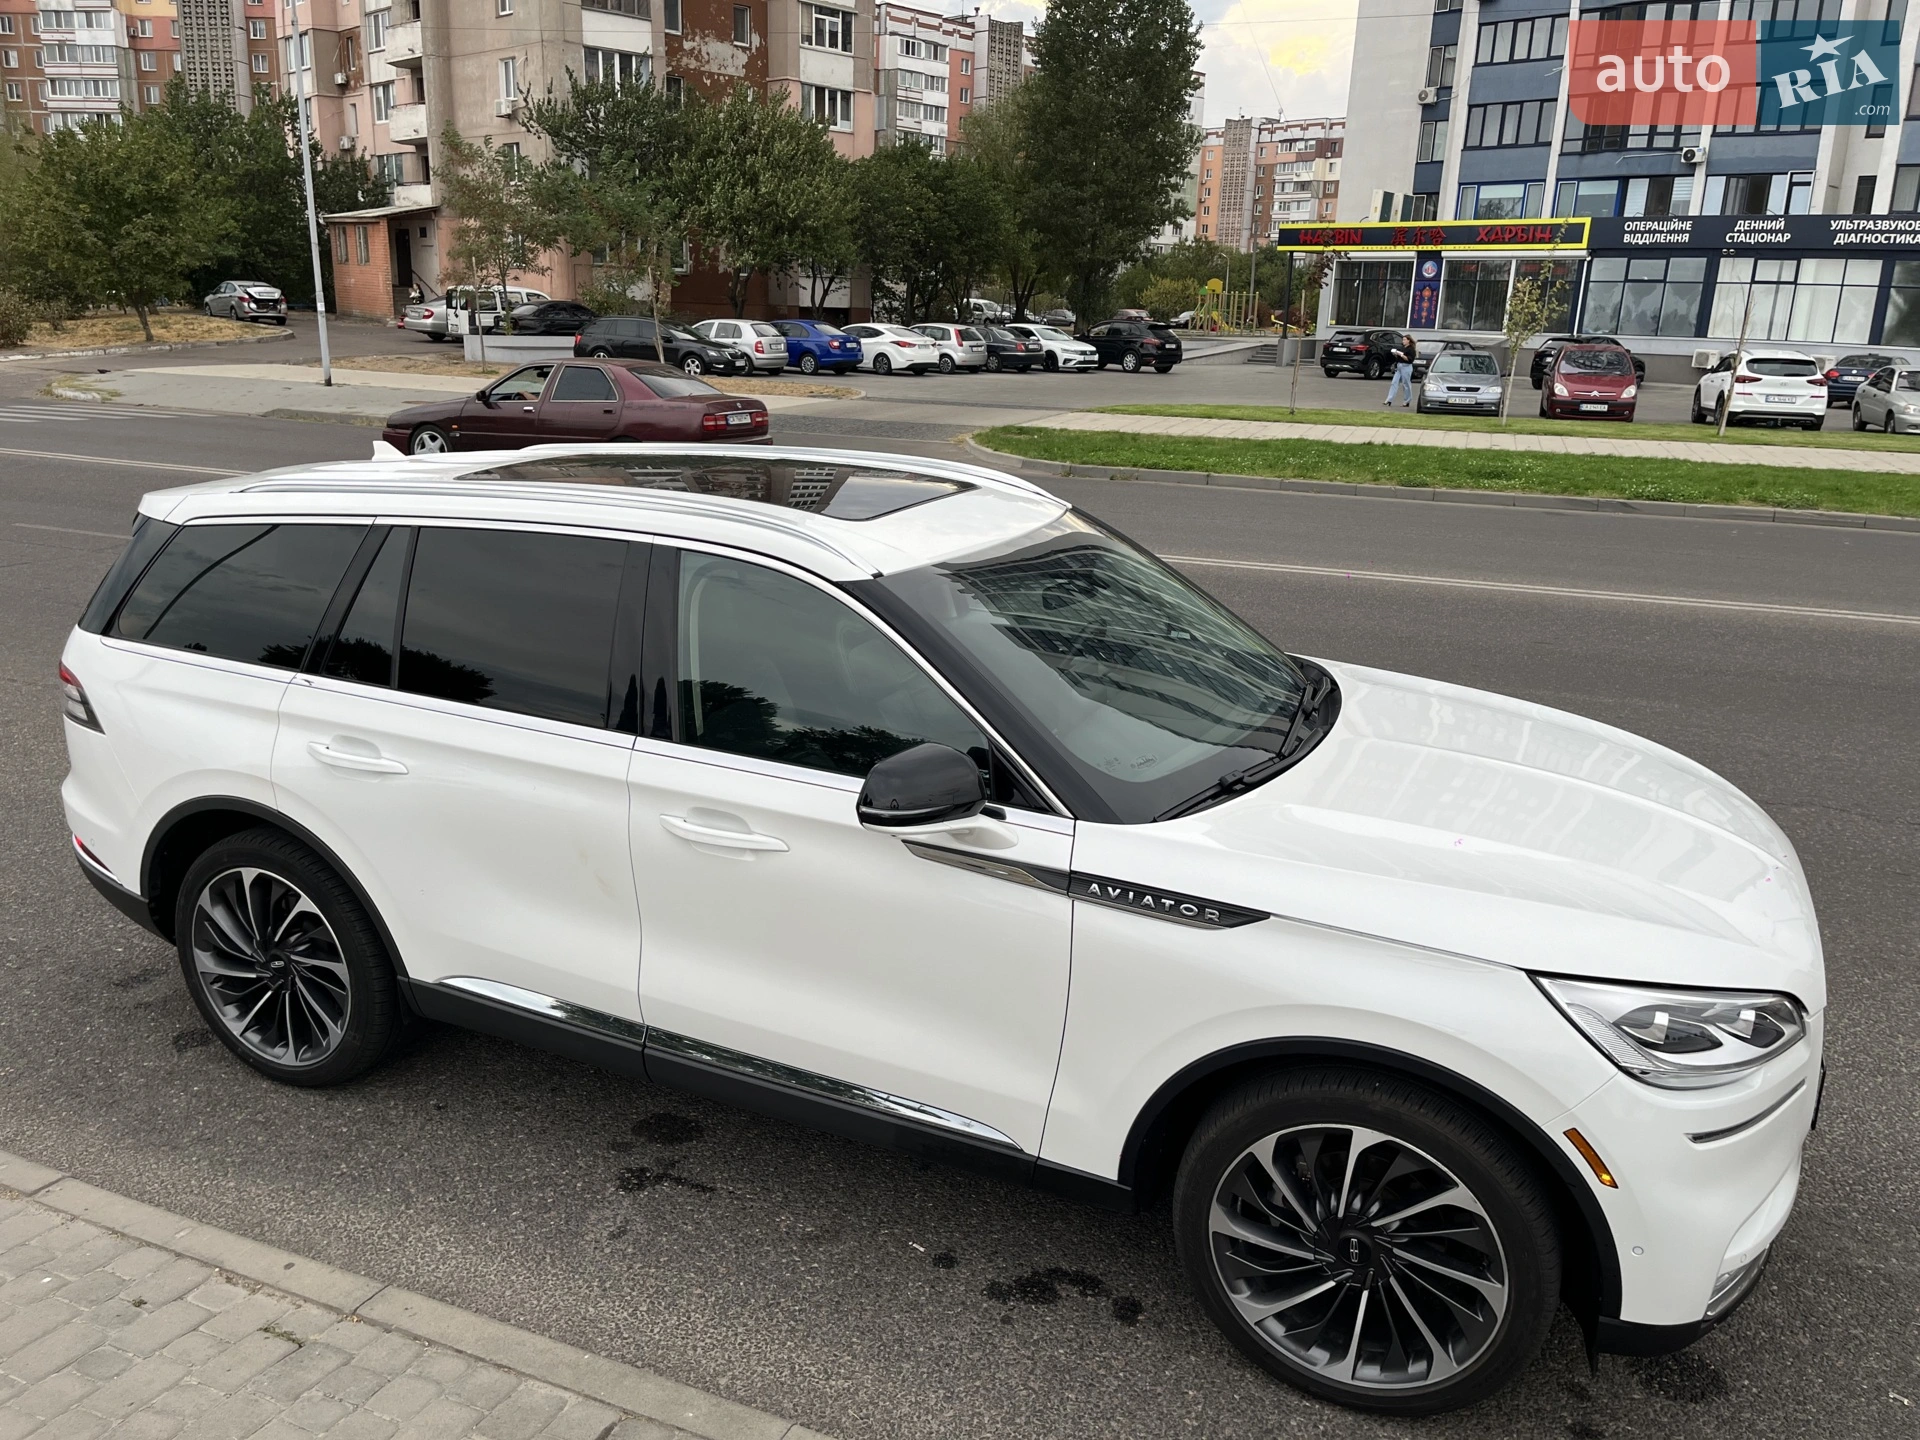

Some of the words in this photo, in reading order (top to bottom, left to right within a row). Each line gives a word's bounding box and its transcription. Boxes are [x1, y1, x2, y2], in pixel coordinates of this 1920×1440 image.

[1624, 219, 1693, 232] ОПЕРАЦІЙНЕ
[1734, 217, 1785, 231] ДЕННИЙ
[1475, 225, 1553, 243] ХАРБІН
[1623, 232, 1690, 244] ВІДДІЛЕННЯ
[1725, 232, 1791, 244] СТАЦІОНАР
[1833, 232, 1920, 246] ДІАГНОСТИКА
[1087, 883, 1221, 923] AVIATOR
